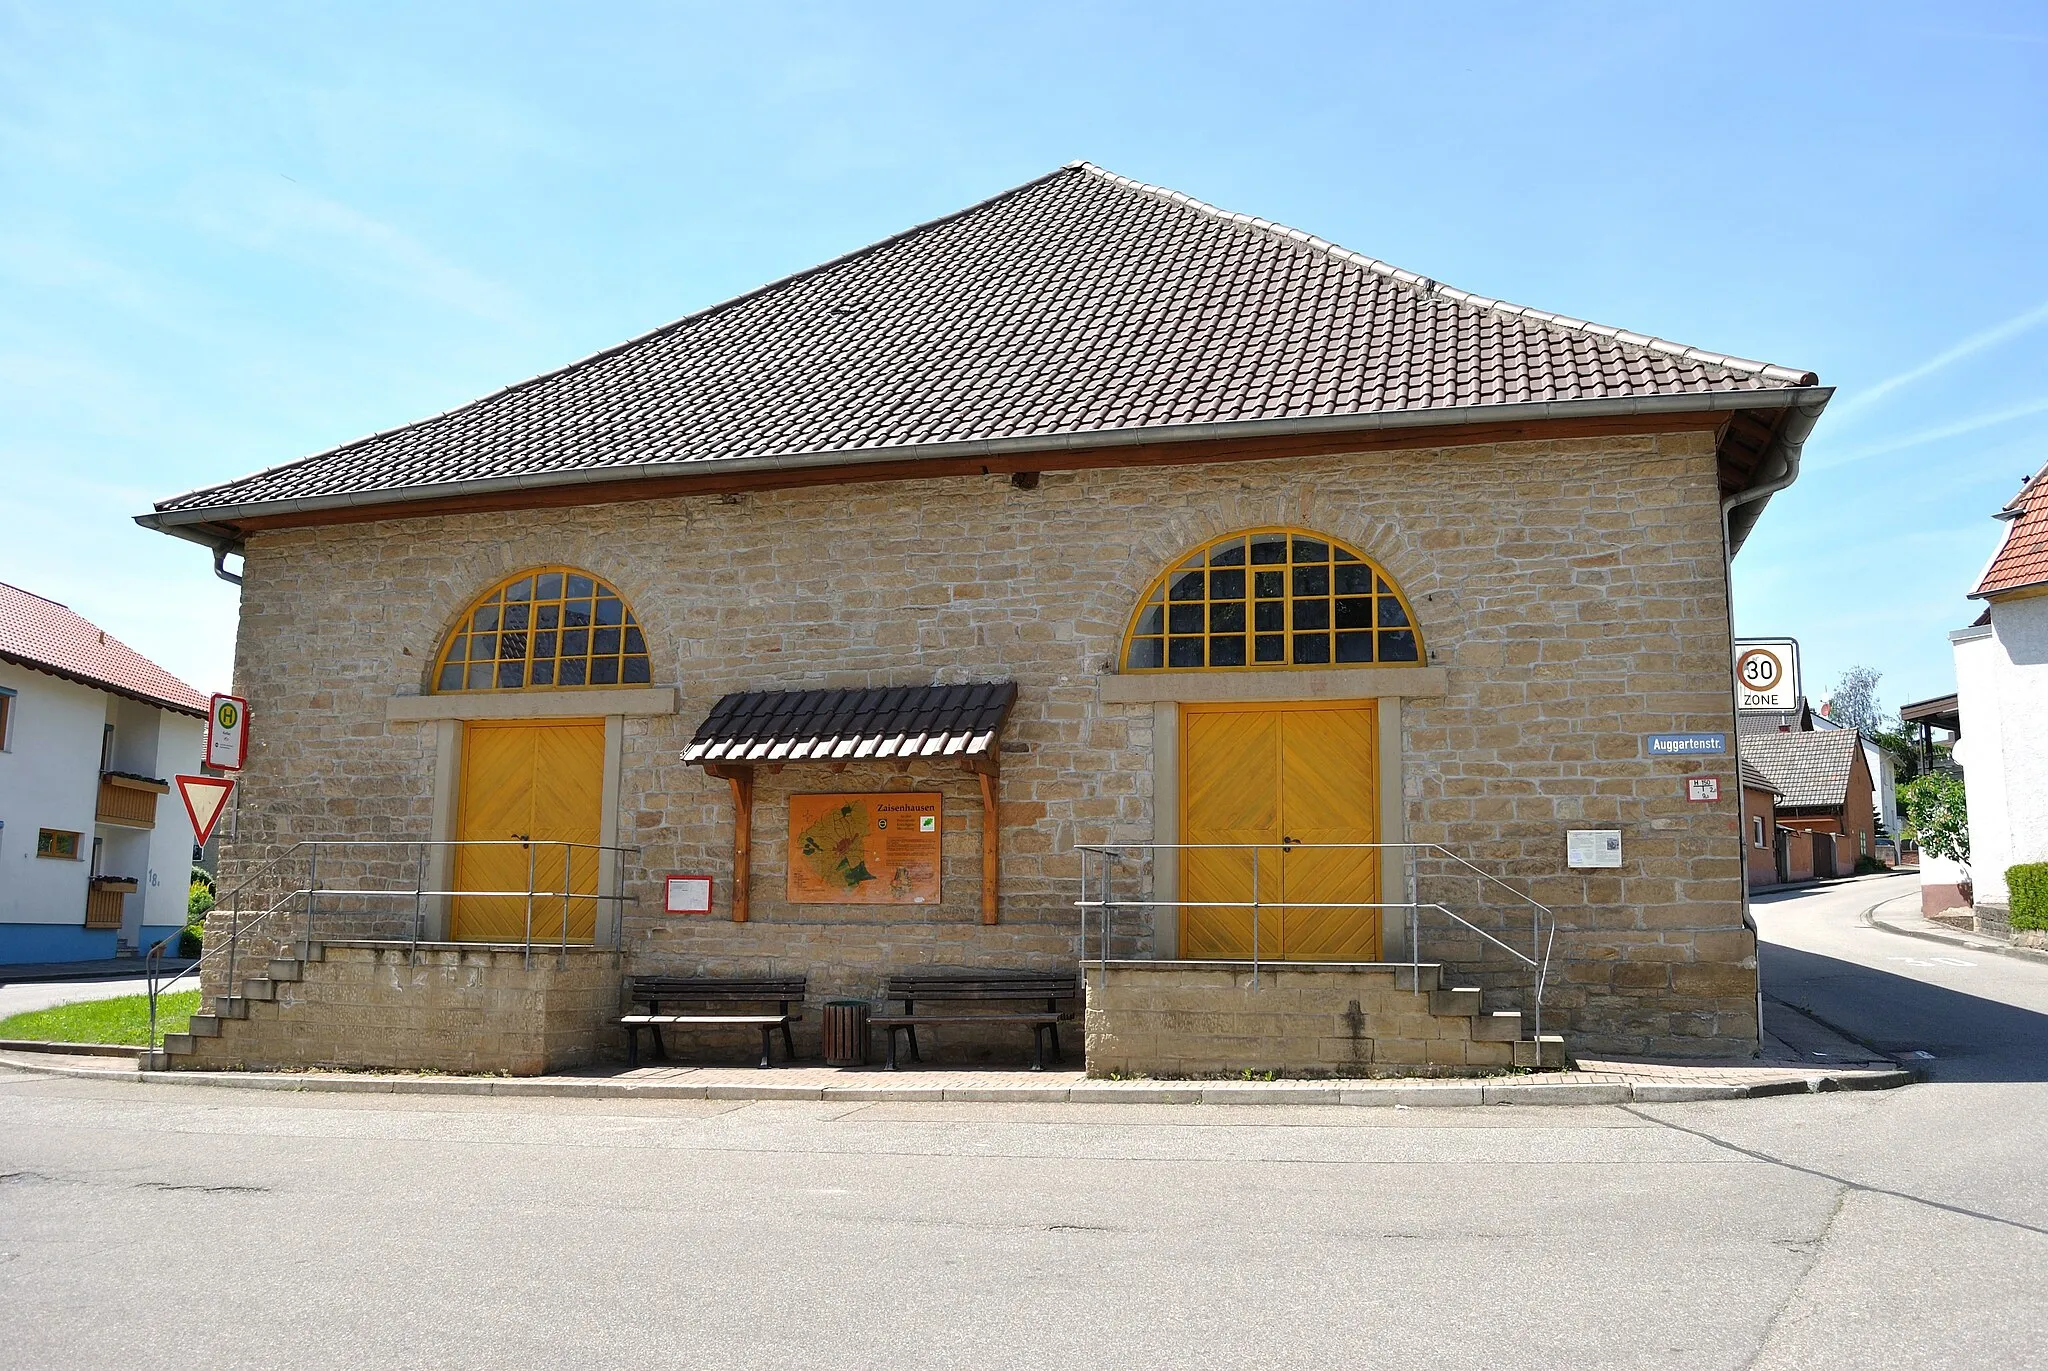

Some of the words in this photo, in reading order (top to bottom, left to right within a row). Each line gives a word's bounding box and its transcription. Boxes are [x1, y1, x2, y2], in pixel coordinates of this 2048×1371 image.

[1746, 661, 1773, 680] 30
[1744, 694, 1779, 706] ZONE
[223, 707, 233, 724] H
[1653, 738, 1721, 752] Auggartenstr.
